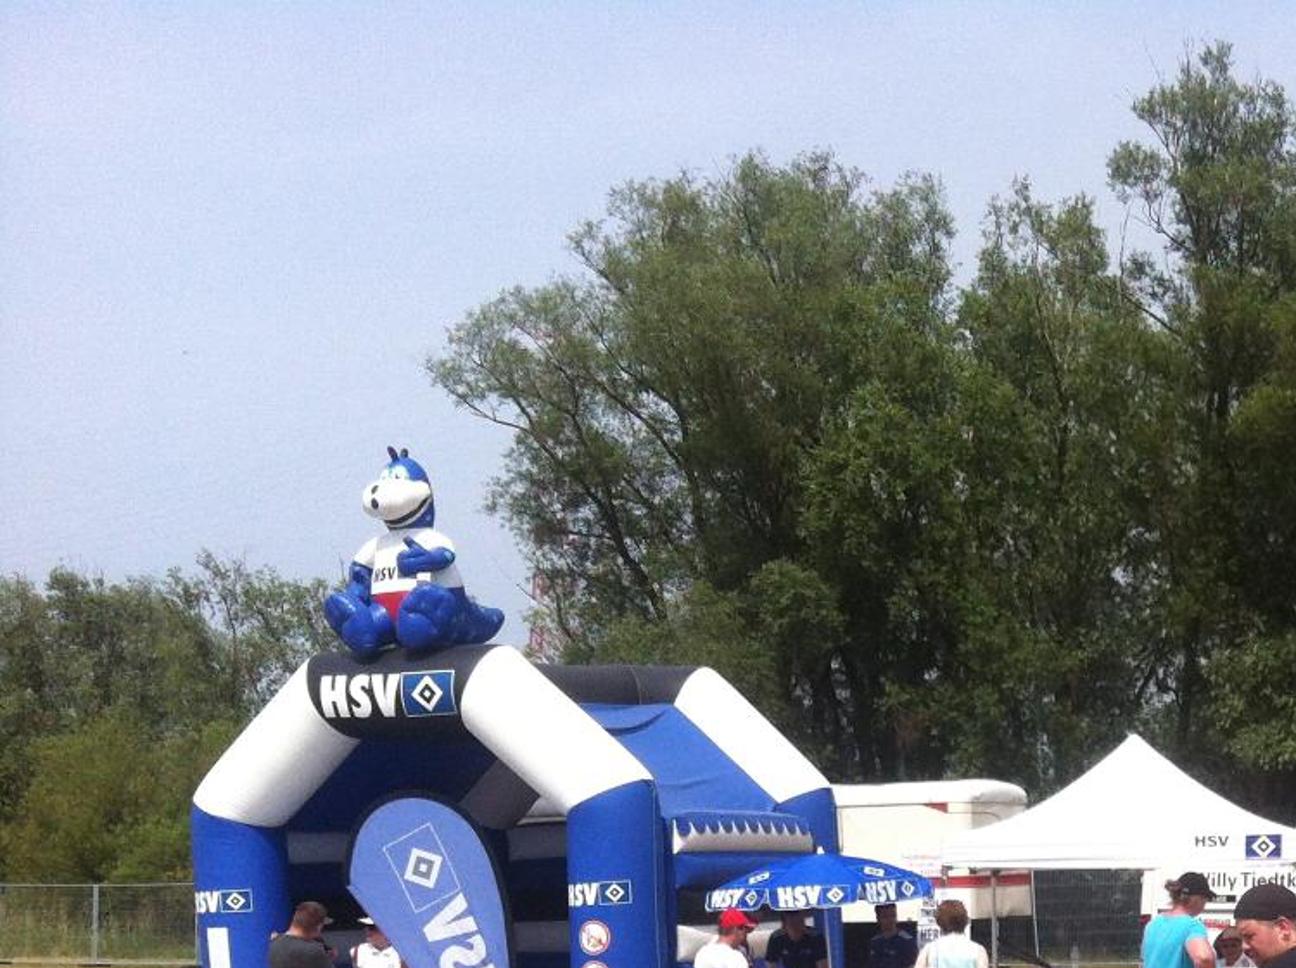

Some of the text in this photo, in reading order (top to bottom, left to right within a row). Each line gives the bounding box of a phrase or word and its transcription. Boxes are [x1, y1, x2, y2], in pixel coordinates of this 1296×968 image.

[320, 673, 400, 718] HSV
[1194, 836, 1229, 847] HSV
[866, 880, 897, 902] HSV
[1206, 872, 1237, 891] illy
[711, 889, 746, 908] HSV
[777, 886, 821, 908] HSV
